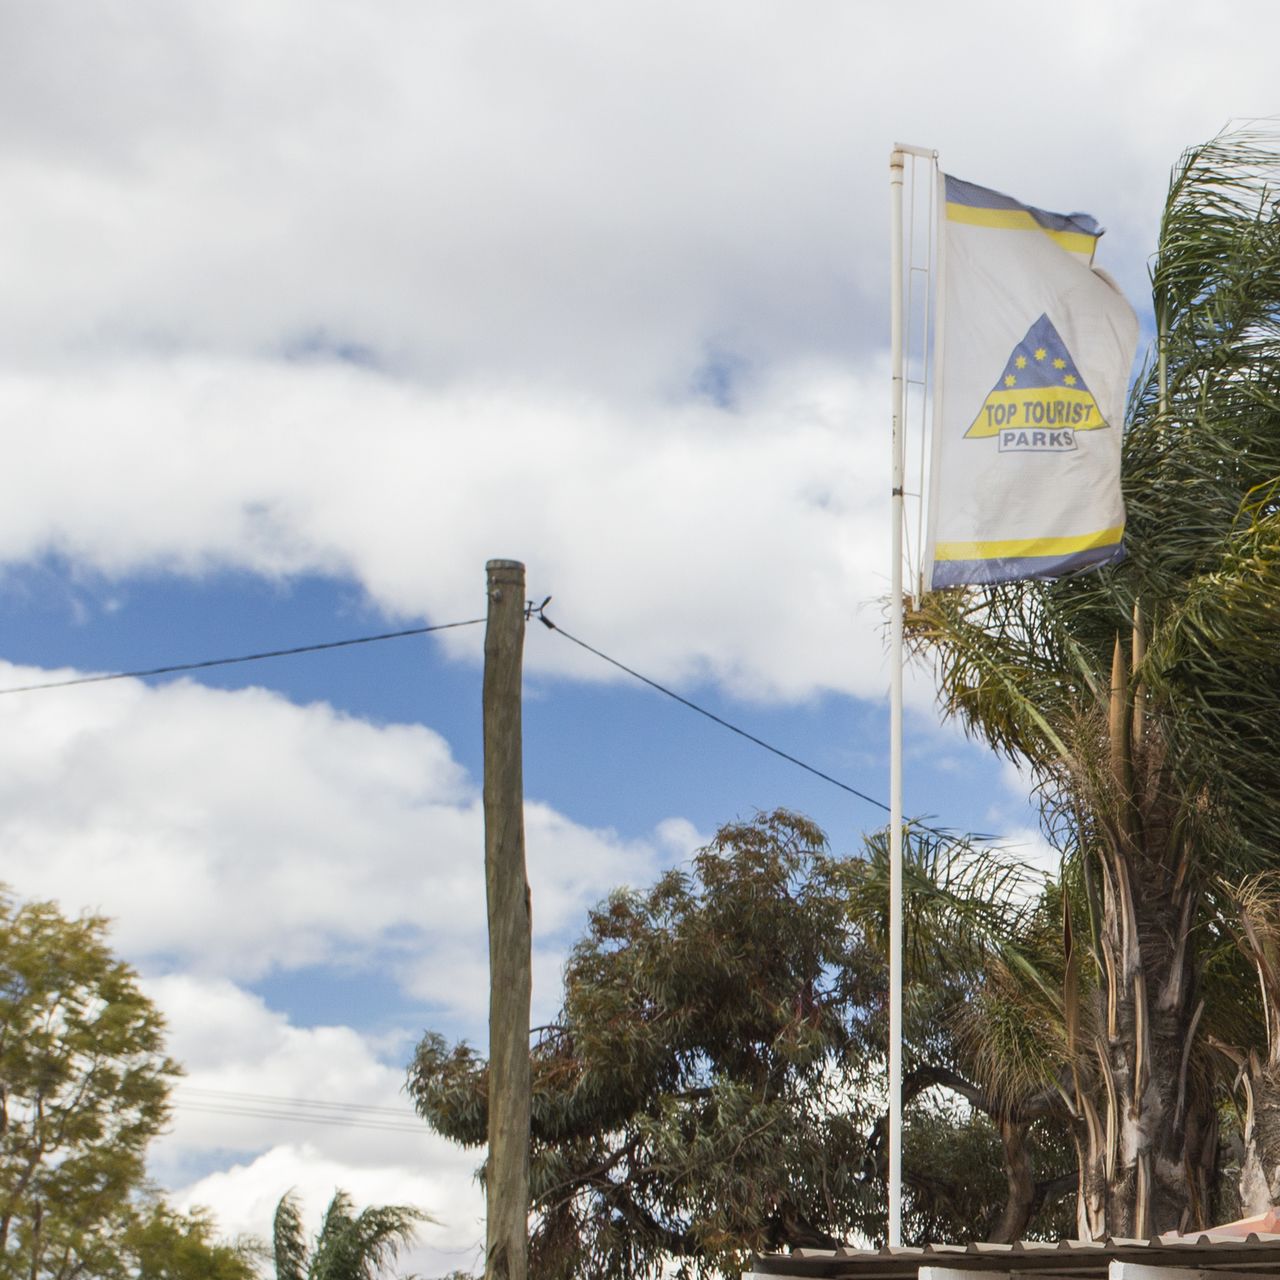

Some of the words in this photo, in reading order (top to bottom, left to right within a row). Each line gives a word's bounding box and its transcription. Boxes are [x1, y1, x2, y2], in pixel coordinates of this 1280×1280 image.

[985, 403, 1017, 427] TOP
[1023, 401, 1093, 424] TOURIST
[1003, 431, 1073, 447] PARKS
